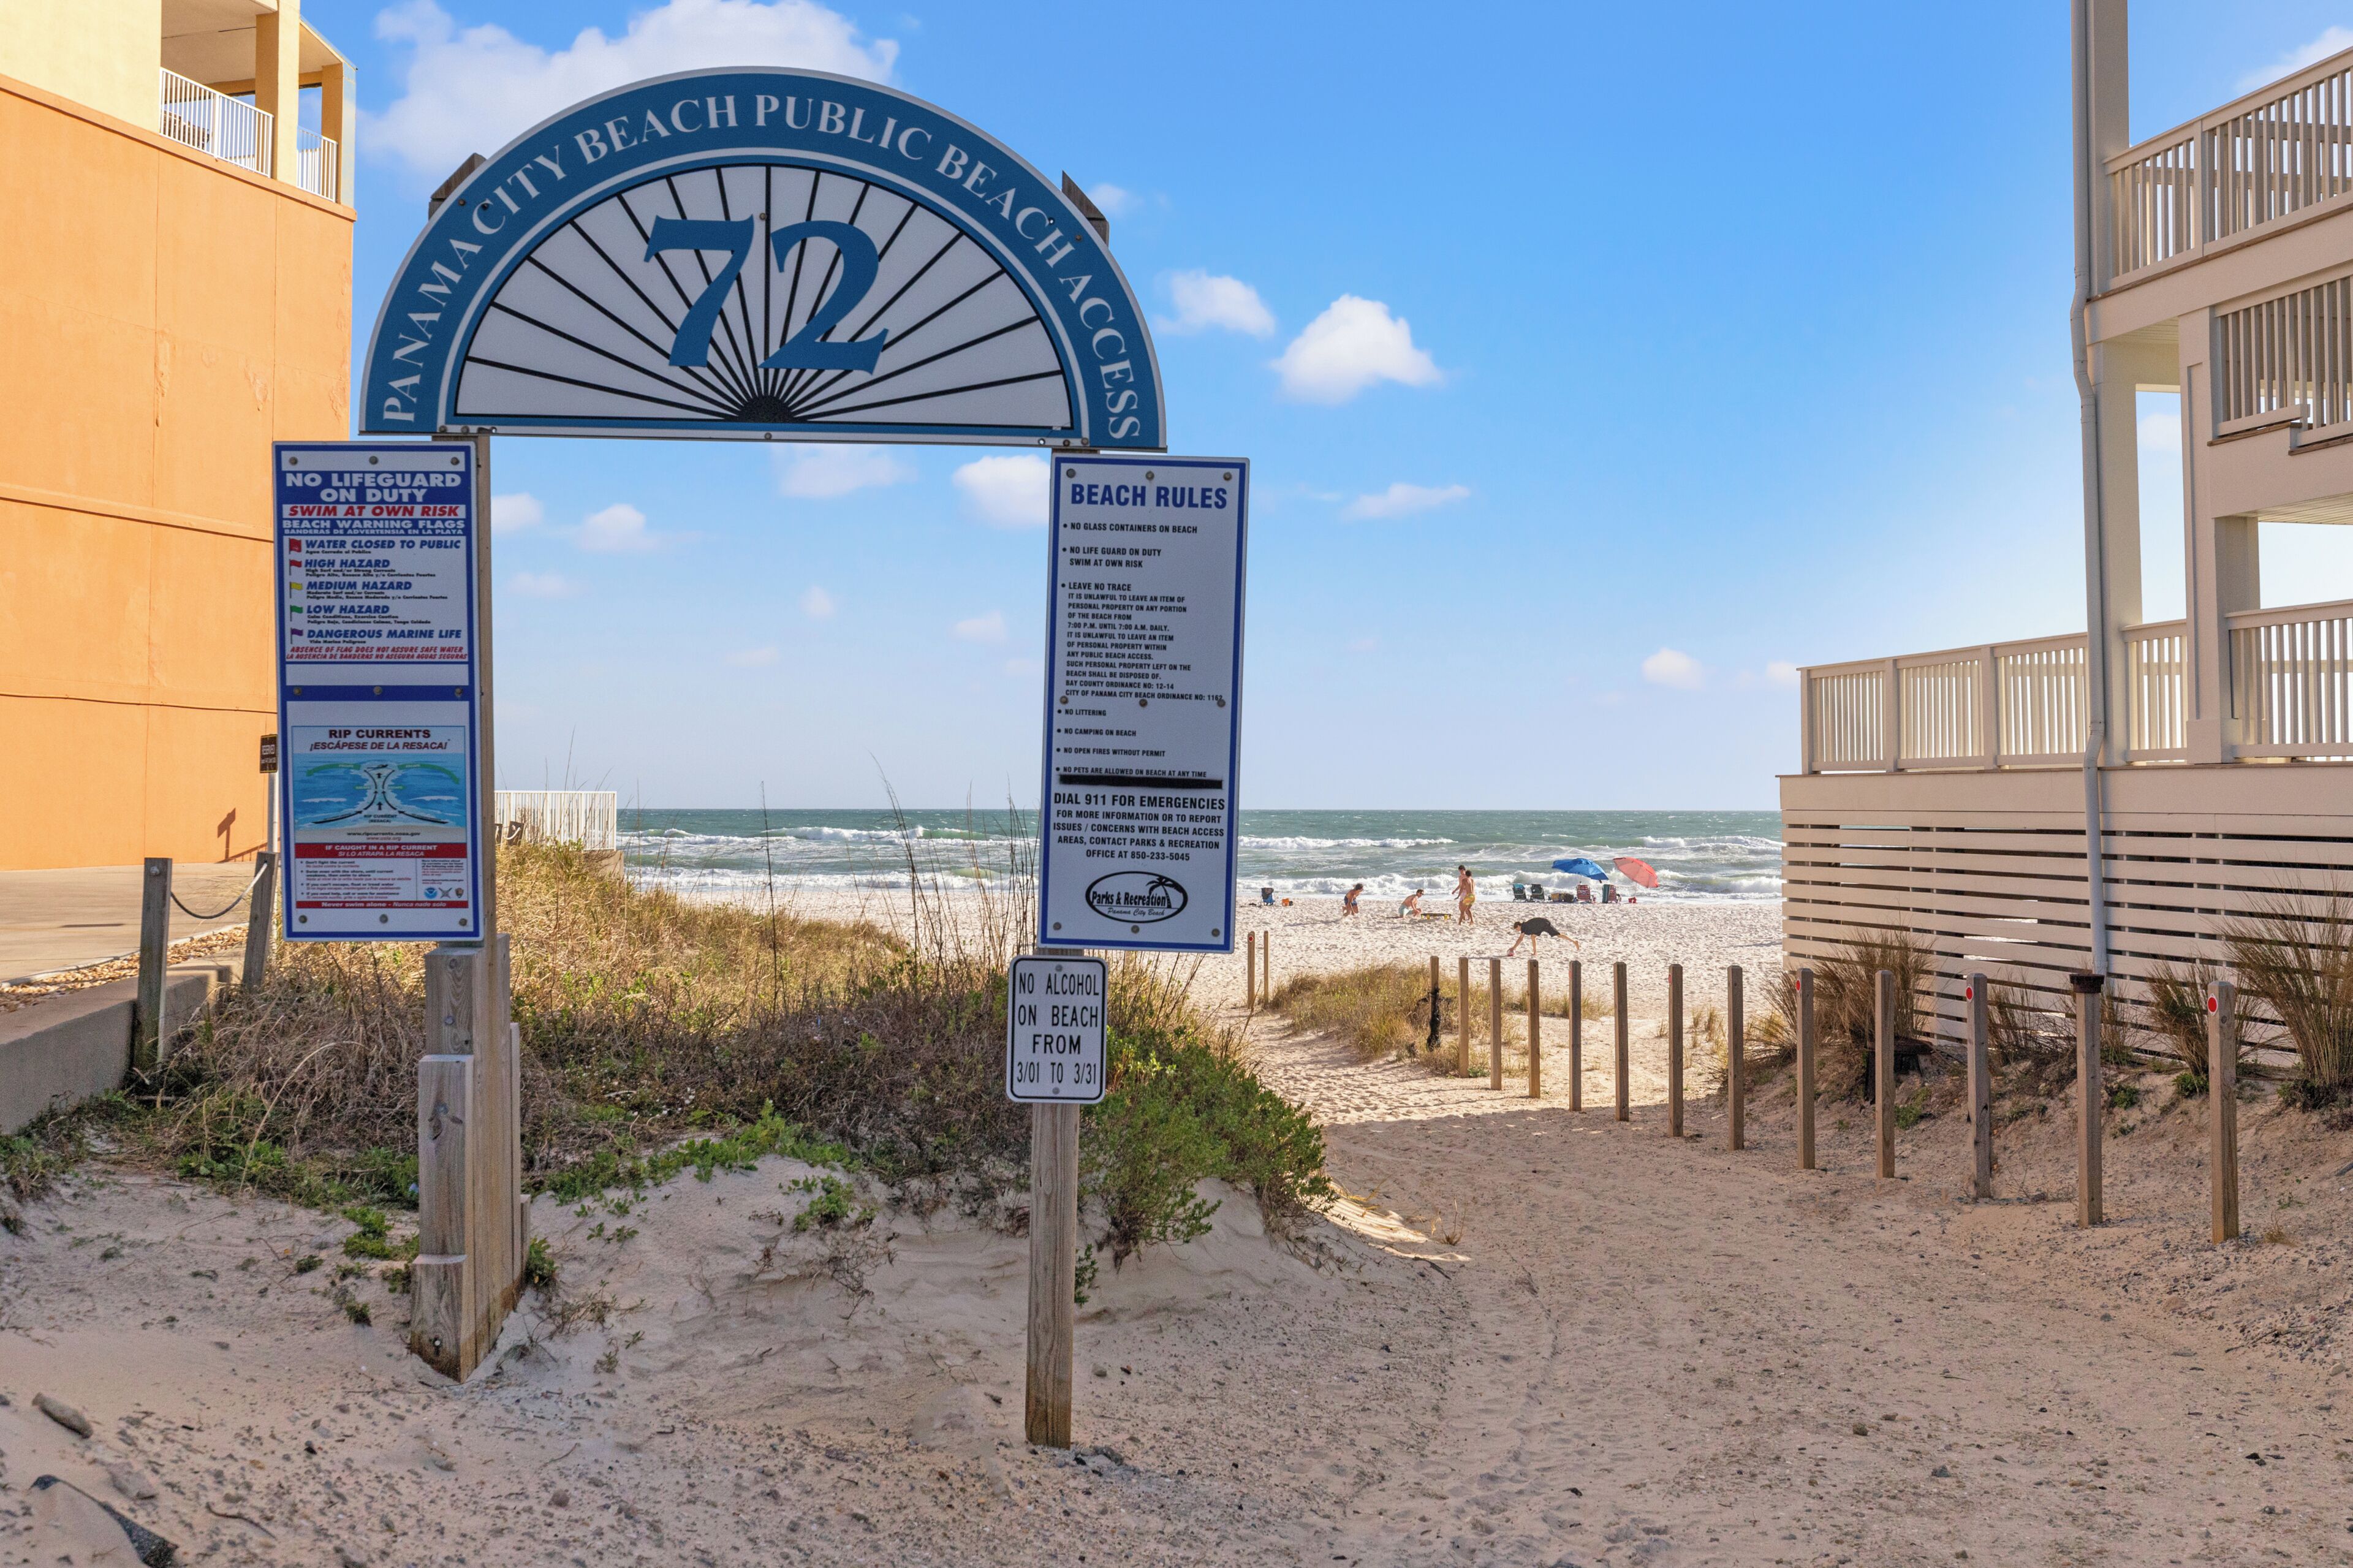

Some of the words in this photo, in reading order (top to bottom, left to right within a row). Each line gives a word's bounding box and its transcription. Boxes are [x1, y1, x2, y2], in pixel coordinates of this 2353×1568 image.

[383, 238, 483, 423] PANAMA
[471, 145, 567, 235] CITY
[574, 95, 738, 164] BEACH
[755, 94, 933, 161] PUBLIC
[935, 143, 1076, 268] BEACH
[1059, 273, 1140, 439] ACCESS
[644, 214, 889, 375] 72
[286, 473, 322, 487] NO
[331, 473, 462, 488] LIFEGUARD
[320, 488, 356, 502] ON
[366, 488, 428, 502] DUTY
[1070, 483, 1146, 507] BEACH
[1156, 486, 1227, 509] RULES
[289, 506, 338, 517] SWIM
[344, 506, 366, 517] AT
[371, 506, 415, 517] OWN
[420, 506, 460, 517] RISK
[282, 520, 330, 529] BEACH
[336, 520, 413, 529] WARNING
[418, 520, 465, 529] FLAGS
[1083, 523, 1107, 531] GLASS
[1109, 523, 1157, 532] CONTAINERS
[1172, 525, 1197, 534] BEACH
[305, 540, 347, 549] WATER
[350, 540, 396, 549] CLOSED
[400, 540, 415, 549] TO
[419, 540, 461, 550] PUBLIC
[1101, 547, 1126, 556] GUARD
[304, 559, 336, 568] HIGH
[339, 559, 390, 569] HAZARD
[1069, 558, 1091, 567] SWIM
[306, 581, 357, 591] MEDIUM
[362, 581, 412, 591] HAZARD
[1069, 582, 1092, 591] LEAVE
[1107, 583, 1132, 591] TRACE
[306, 605, 335, 614] LOW
[339, 605, 390, 614] HAZARD
[307, 629, 383, 638] DANGEROUS
[387, 629, 434, 638] MARINE
[438, 629, 462, 638] LIFE
[328, 729, 351, 738] RIP
[355, 729, 431, 738] CURRENTS
[309, 740, 368, 752] ¡ESCÁPESE
[1054, 793, 1081, 805] DIAL
[1085, 793, 1107, 805] 911
[1112, 794, 1135, 807] FOR
[1140, 796, 1225, 811] EMERGENCIES
[1056, 809, 1073, 818] FOR
[1075, 810, 1100, 819] MORE
[1102, 811, 1159, 821] INFORMATION
[1161, 813, 1173, 822] OR
[1189, 814, 1221, 824] REPORT
[1053, 822, 1083, 831] ISSUES
[1091, 824, 1135, 833] CONCERNS
[1138, 825, 1159, 834] WITH
[1162, 826, 1189, 835] BEACH
[1192, 827, 1224, 836] ACCESS
[1058, 835, 1087, 846] AREAS,
[1089, 836, 1127, 846] CONTACT
[1129, 838, 1156, 847] PARKS
[1159, 839, 1165, 847] &
[1168, 839, 1219, 849] RECREATION
[1086, 849, 1115, 858] OFFICE
[1118, 850, 1129, 858] AT
[1131, 850, 1190, 861] 850-233-5045
[1091, 890, 1114, 904] Parks
[1116, 892, 1122, 905] &
[1123, 892, 1167, 907] Recreation
[1133, 907, 1146, 917] City
[1019, 972, 1034, 994] NO
[1046, 973, 1099, 996] ALCOHOL
[1018, 1004, 1037, 1026] ON
[1051, 1005, 1098, 1028] BEACH
[1033, 1034, 1081, 1055] FROM
[1017, 1061, 1040, 1083] 3/01
[1050, 1062, 1064, 1083] TO
[1074, 1062, 1096, 1085] 3/31
